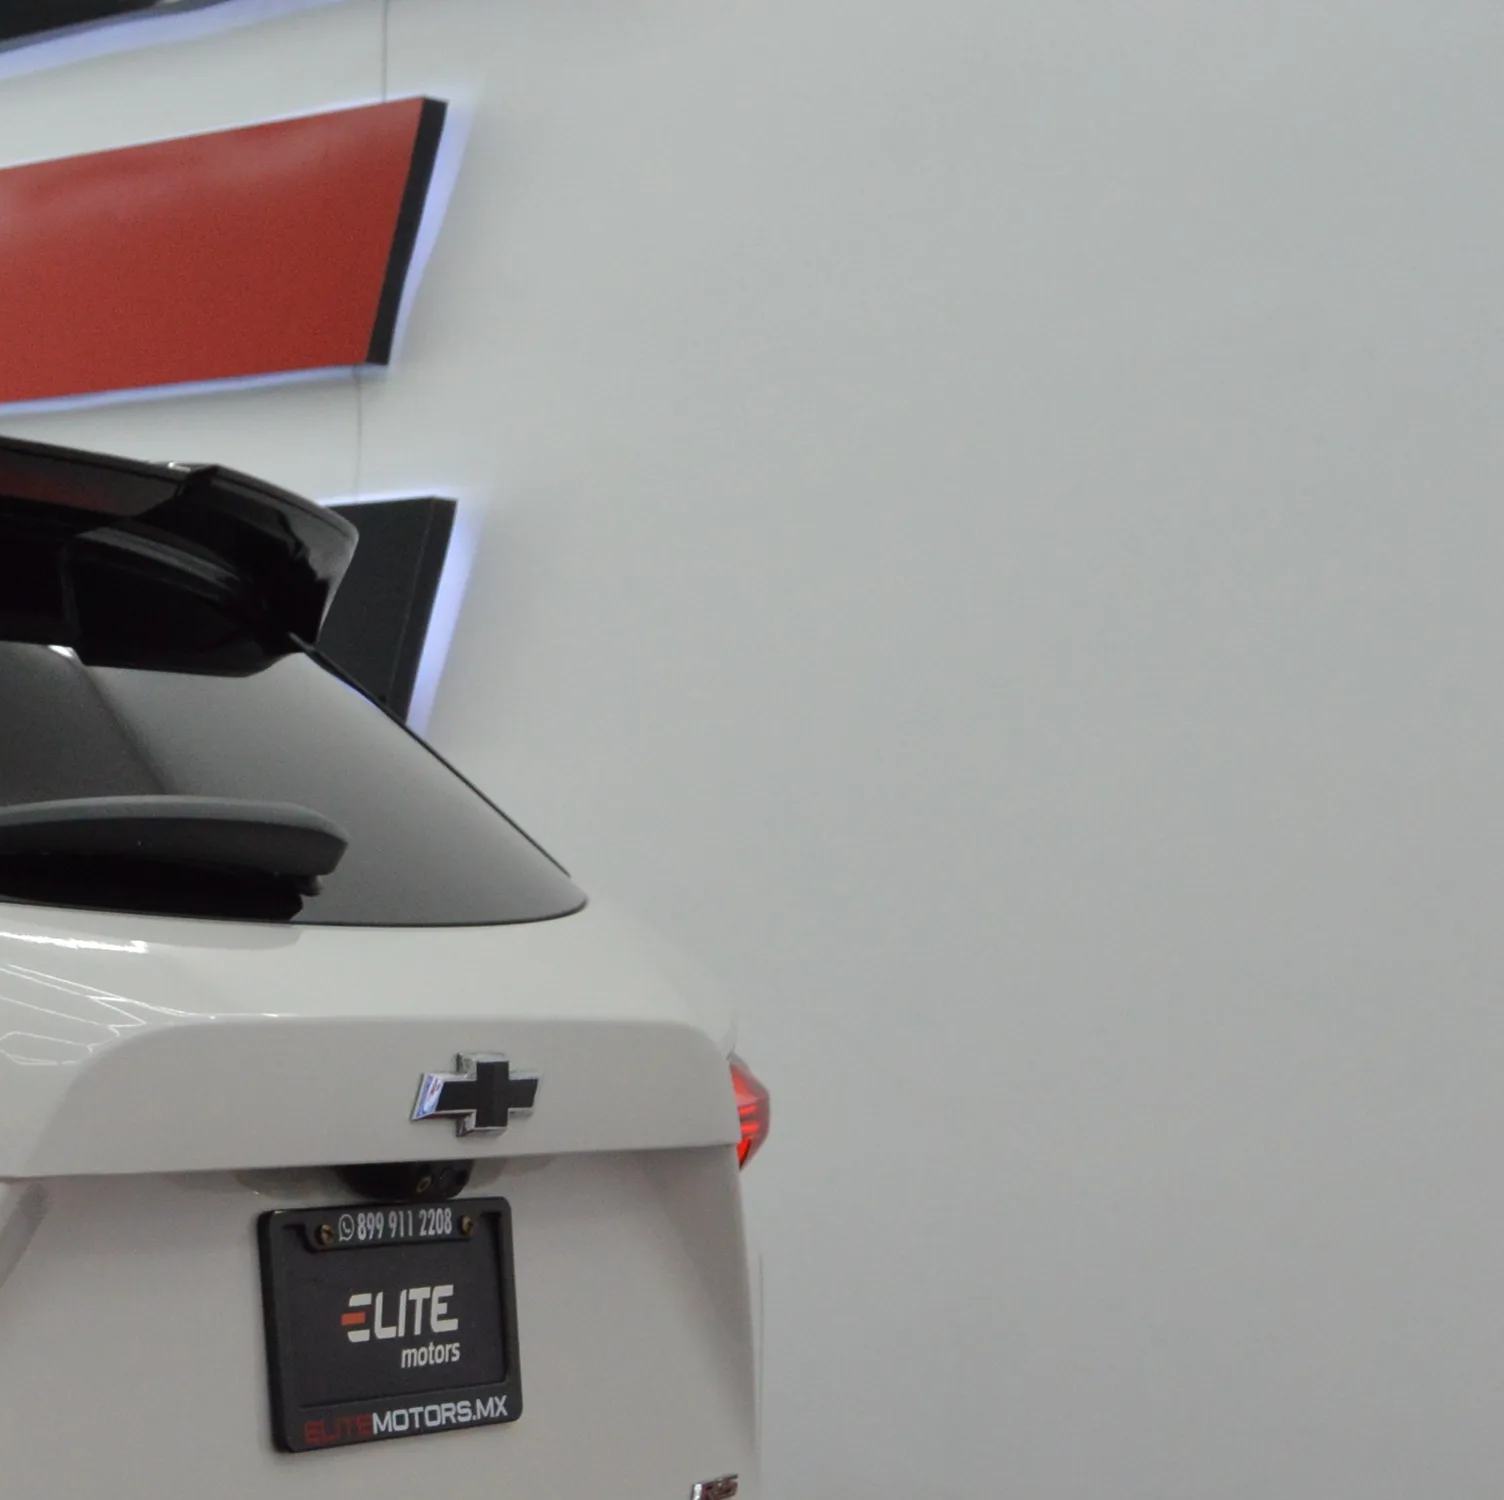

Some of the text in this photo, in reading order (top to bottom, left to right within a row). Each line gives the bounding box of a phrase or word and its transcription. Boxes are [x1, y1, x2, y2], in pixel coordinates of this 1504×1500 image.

[357, 1207, 452, 1241] 899 911 2208
[340, 1284, 459, 1343] ELITE
[400, 1341, 460, 1369] motors
